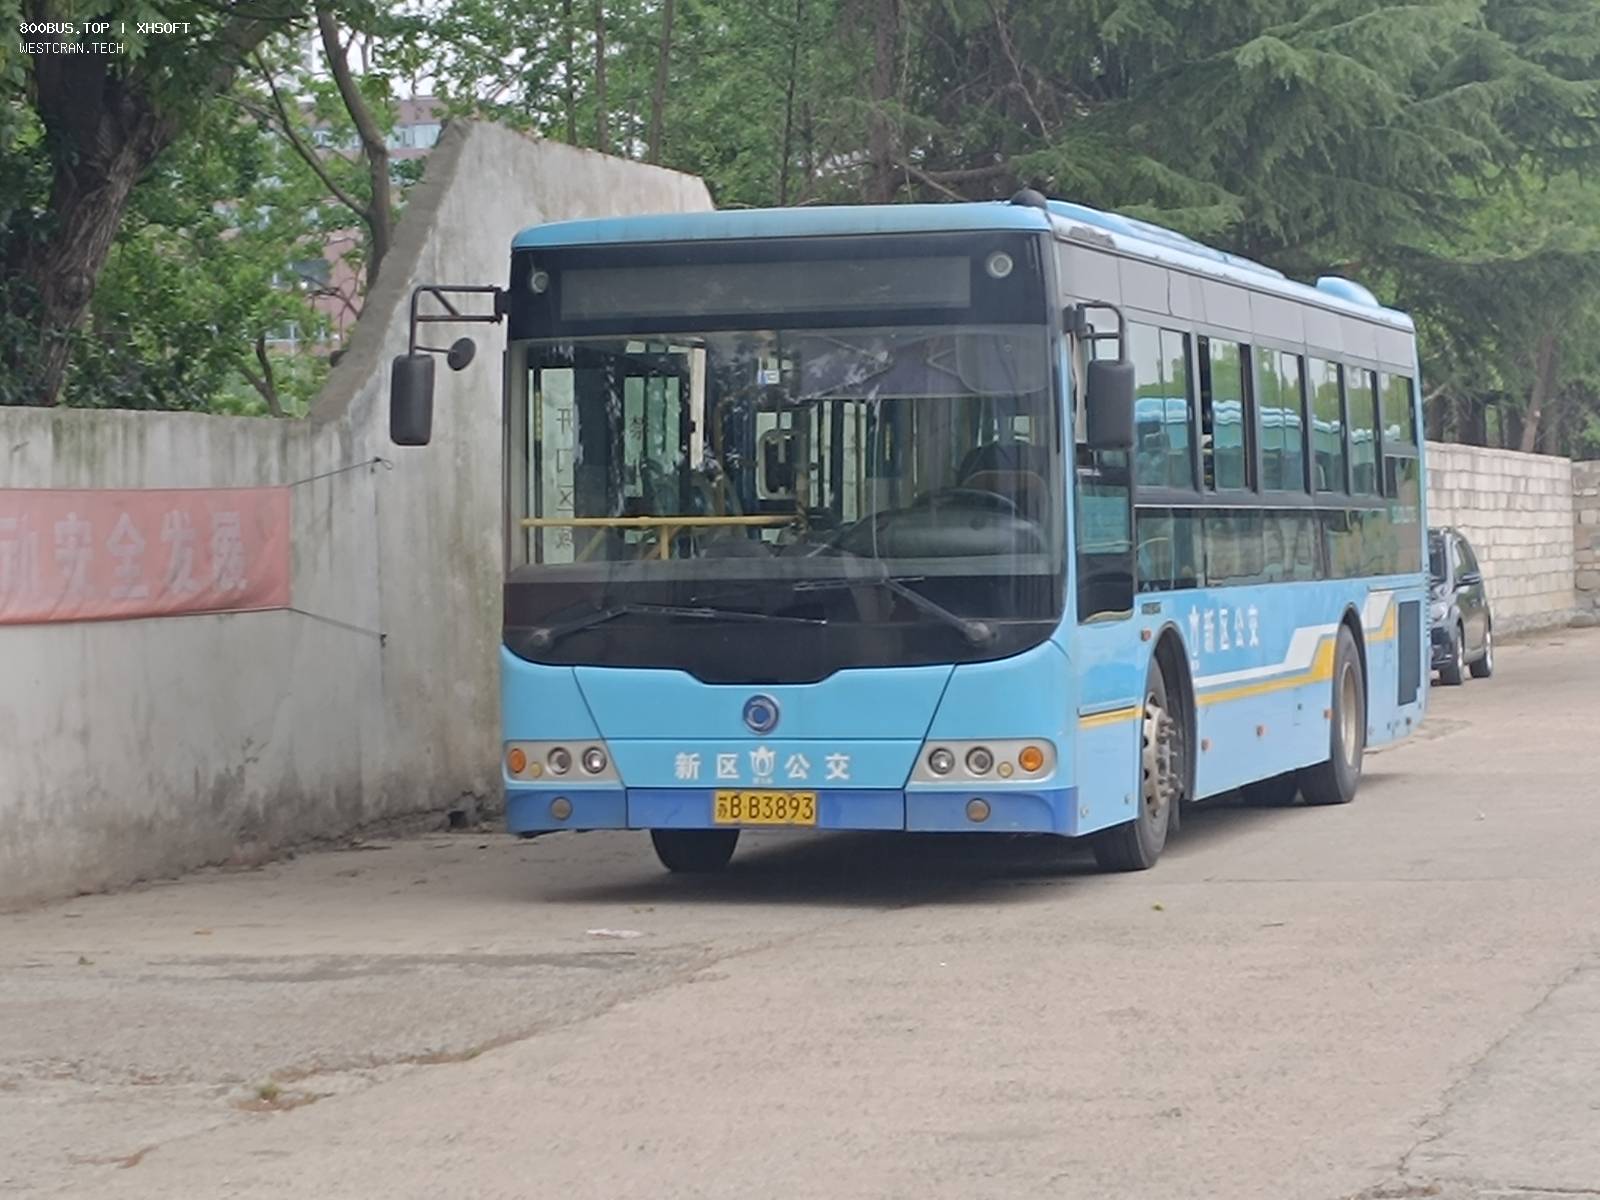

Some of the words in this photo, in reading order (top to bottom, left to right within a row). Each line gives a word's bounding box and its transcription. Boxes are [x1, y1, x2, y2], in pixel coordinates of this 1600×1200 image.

[1203, 604, 1259, 653] 新区公交
[674, 752, 740, 780] 新区
[784, 752, 851, 781] 公交
